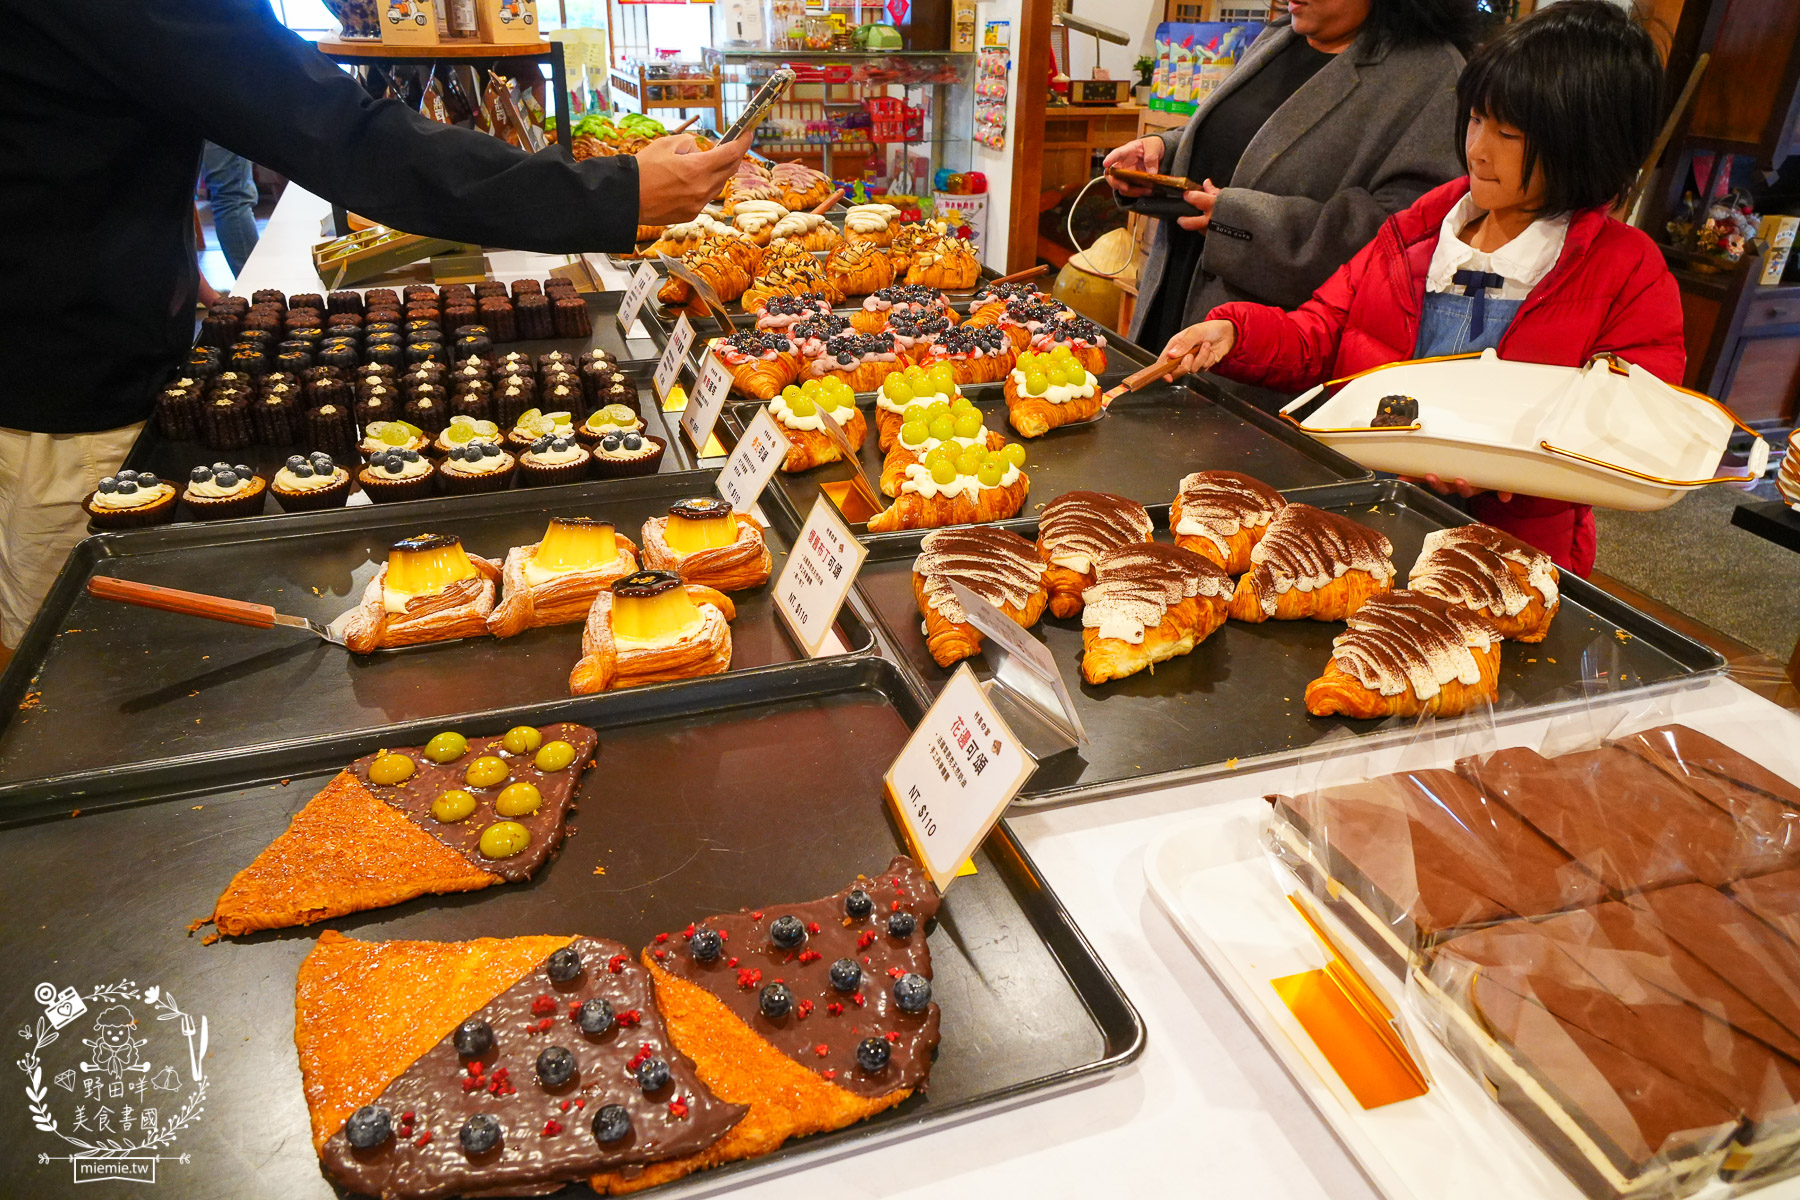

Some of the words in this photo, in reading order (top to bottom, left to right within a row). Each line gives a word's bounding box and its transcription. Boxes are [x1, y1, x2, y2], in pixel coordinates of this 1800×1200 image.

[795, 604, 807, 623] $110
[973, 712, 990, 735] 村長の家
[949, 716, 988, 774] 花邊可頌
[908, 785, 920, 806] NT.
[918, 805, 936, 835] $110
